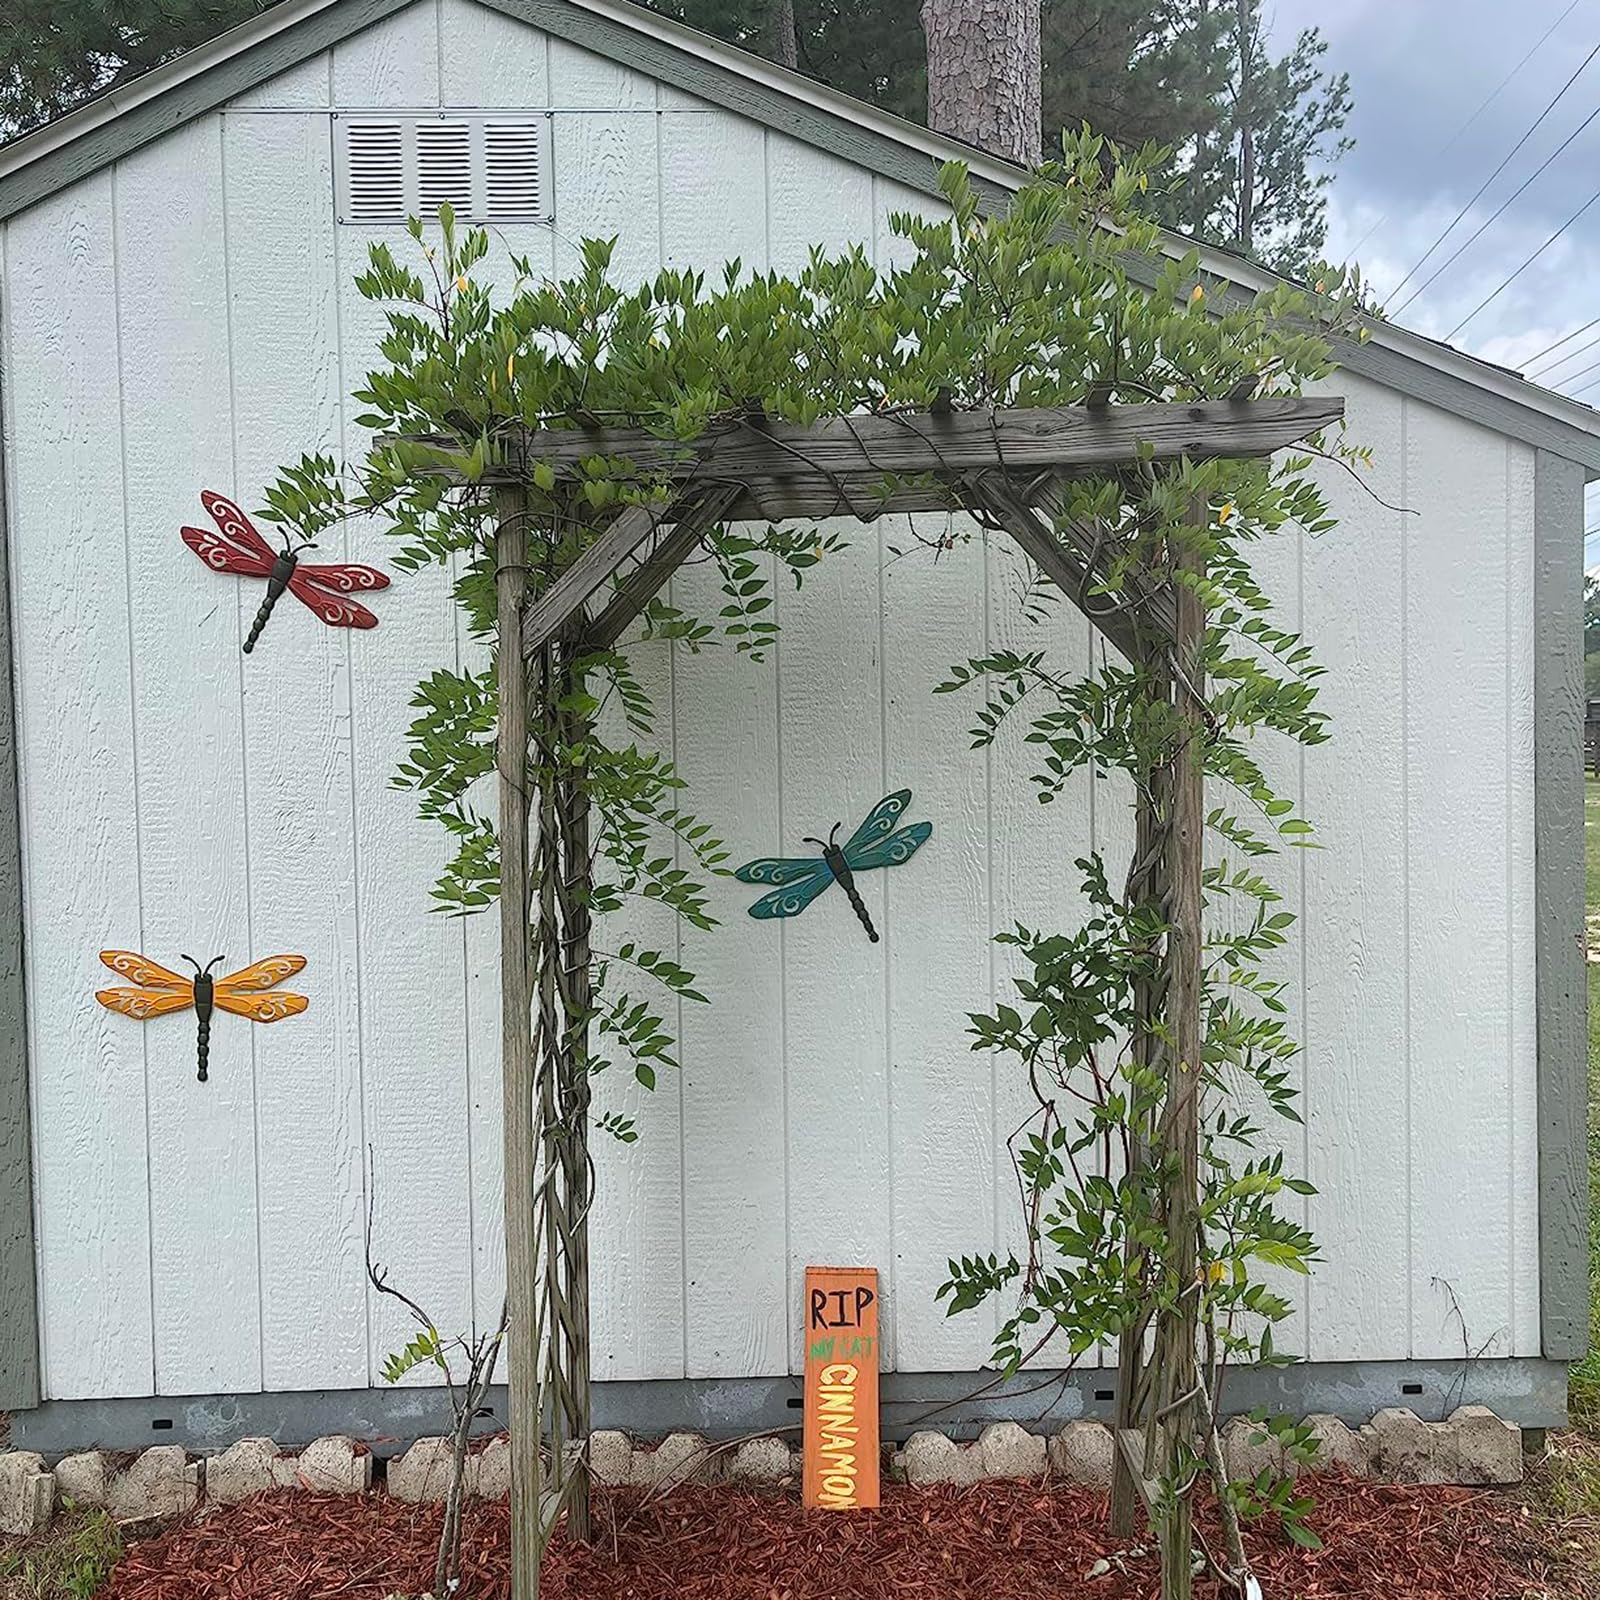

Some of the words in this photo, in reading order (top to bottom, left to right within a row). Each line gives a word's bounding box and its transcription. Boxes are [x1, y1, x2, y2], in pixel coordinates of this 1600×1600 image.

[811, 1287, 873, 1330] RIP
[839, 1335, 873, 1360] CAT
[817, 1363, 859, 1510] CINNAMON
